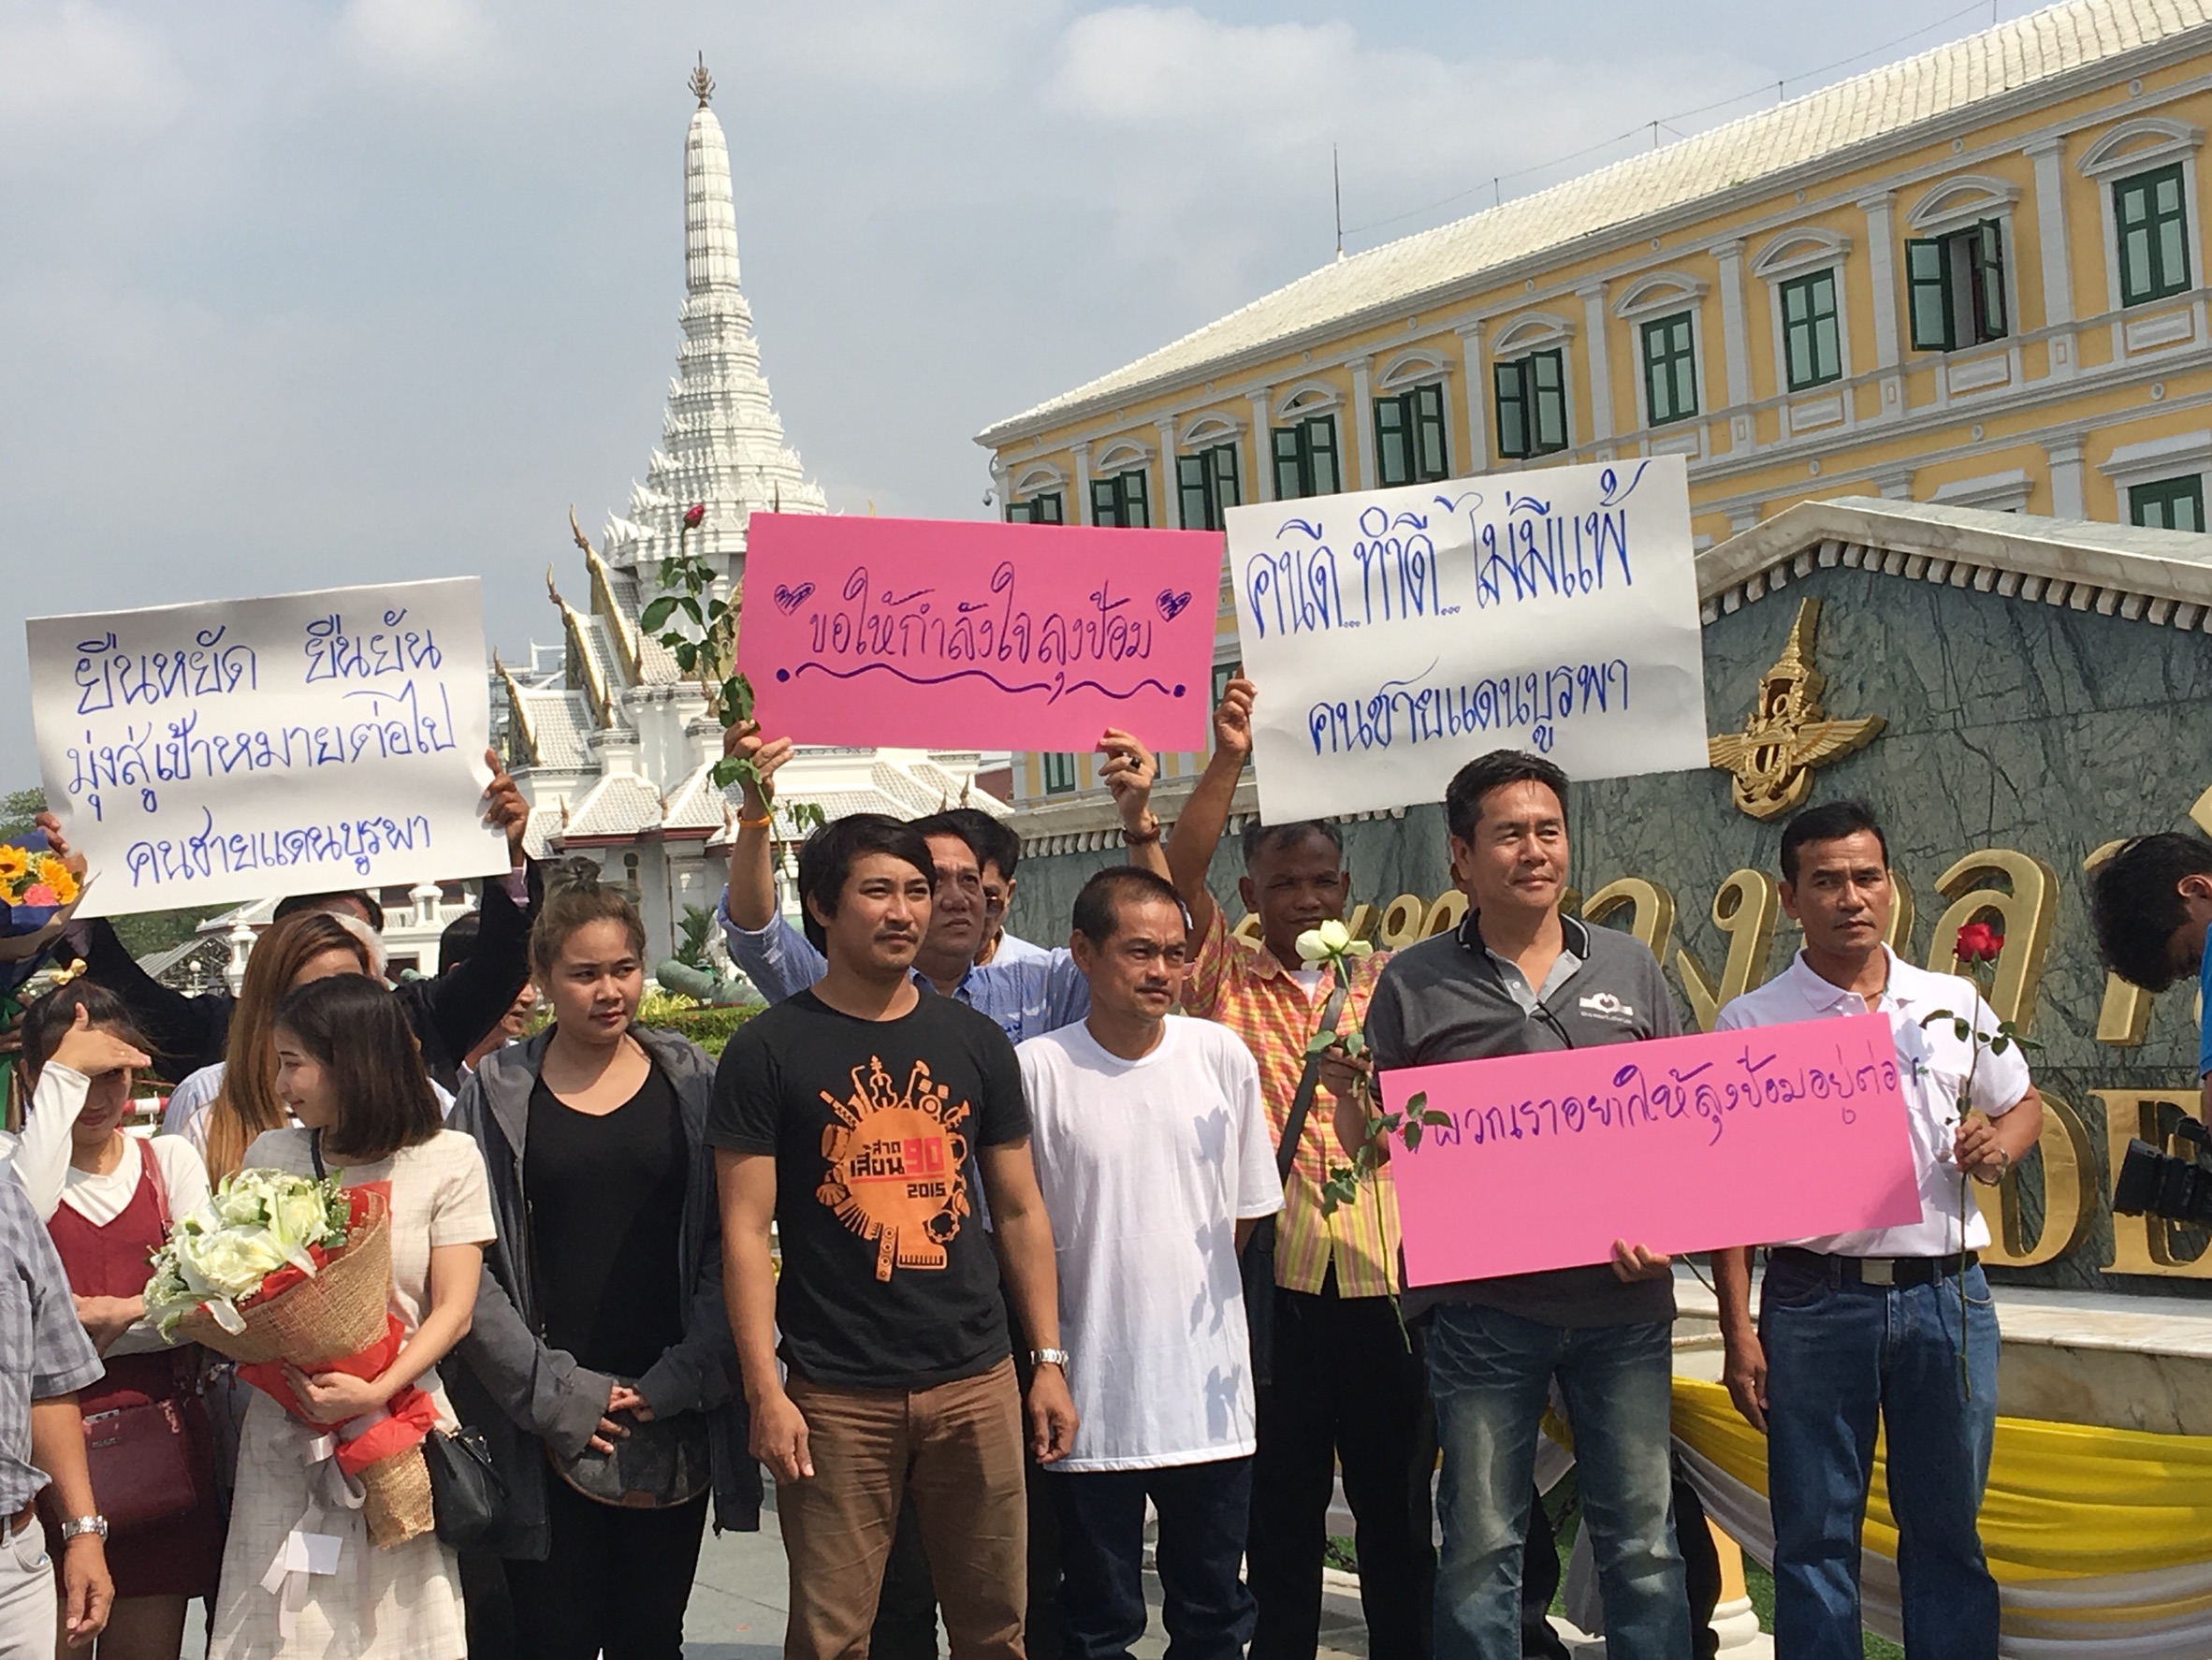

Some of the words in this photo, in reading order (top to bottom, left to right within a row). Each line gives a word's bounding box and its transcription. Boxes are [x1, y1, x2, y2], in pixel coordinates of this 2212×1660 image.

[75, 625, 256, 715] ยืนหยัด
[304, 608, 443, 684] ยืนยัน
[1308, 656, 1629, 755] คนชายแดนบูรพา
[67, 679, 458, 822] มุ่งสู่เป้าหมายต่อไป
[125, 806, 430, 889] คนชายแดนบูรพา
[903, 1137, 945, 1173] 90
[907, 1182, 946, 1198] 2015
